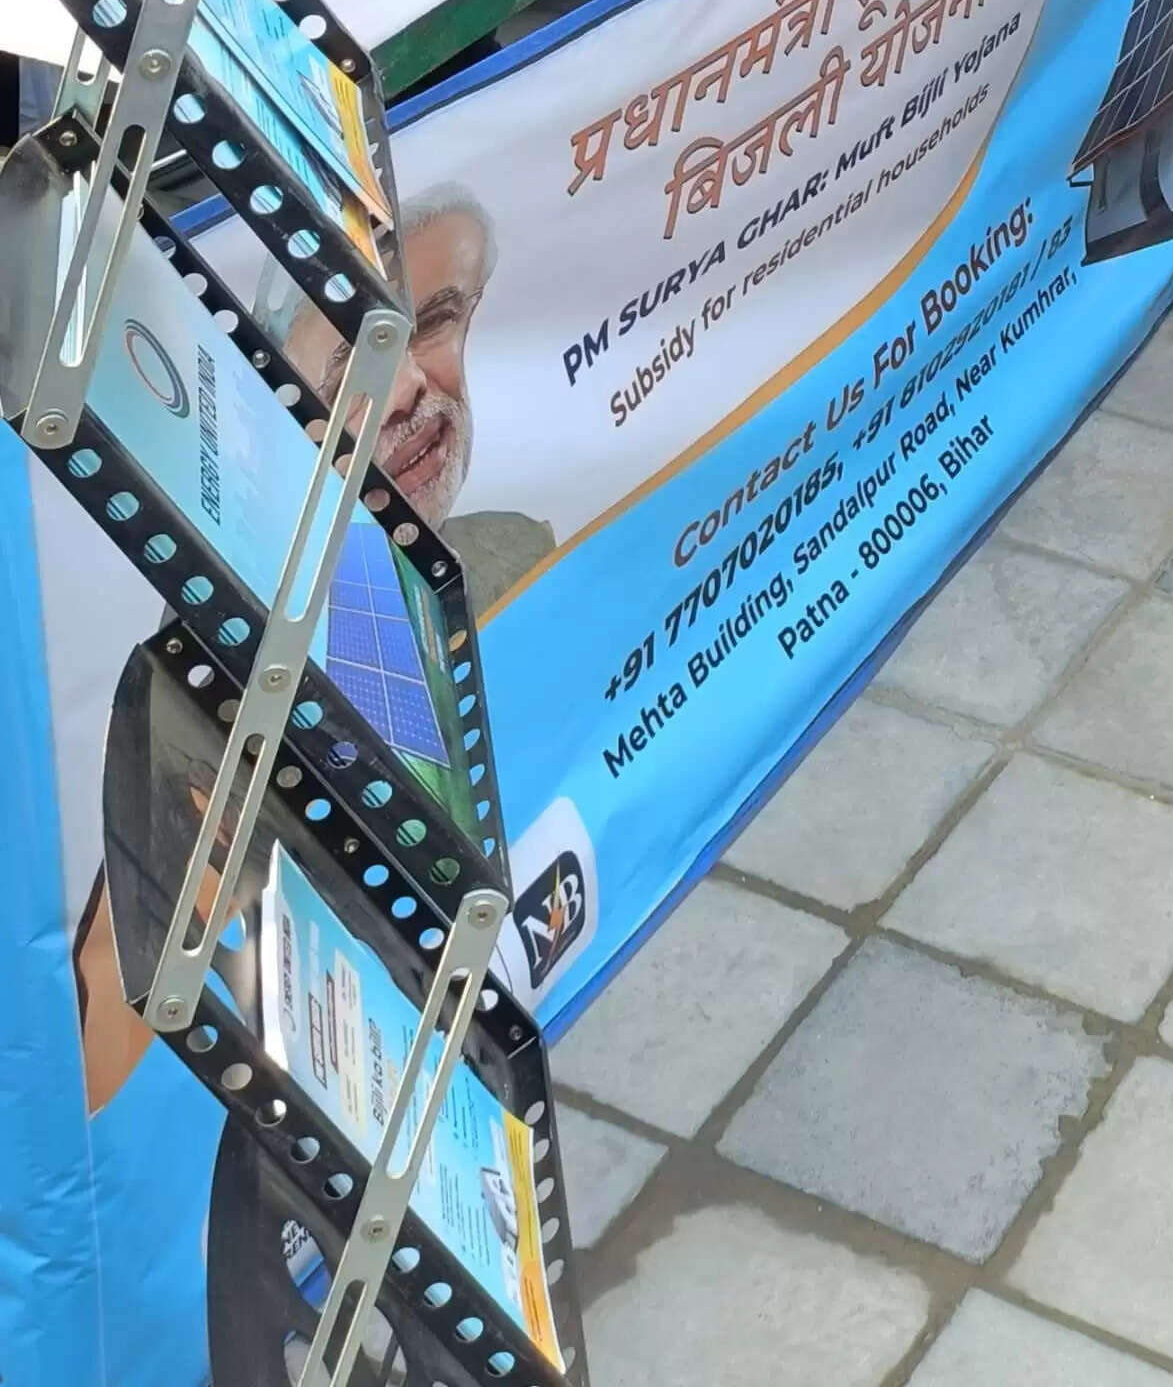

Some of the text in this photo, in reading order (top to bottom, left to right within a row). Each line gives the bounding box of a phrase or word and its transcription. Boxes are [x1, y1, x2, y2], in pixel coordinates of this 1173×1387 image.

[562, 11, 1023, 385] PM SURYA GHAR: Muft Bijli Yojana
[609, 82, 992, 428] Subsidy for residential households
[661, 45, 852, 240] बिजली
[197, 343, 221, 527] ENERGY UNITED INDIA
[602, 266, 1078, 780] Mehta Building, Sandalpur Road, Near Kumhrar,
[673, 197, 1035, 569] Contact Us For Booking:
[777, 579, 851, 660] Patna
[858, 472, 950, 572] 800006,
[937, 411, 996, 482] Bihar
[604, 631, 656, 702] +91
[664, 455, 845, 648] 7707020185,
[852, 395, 896, 450] +91
